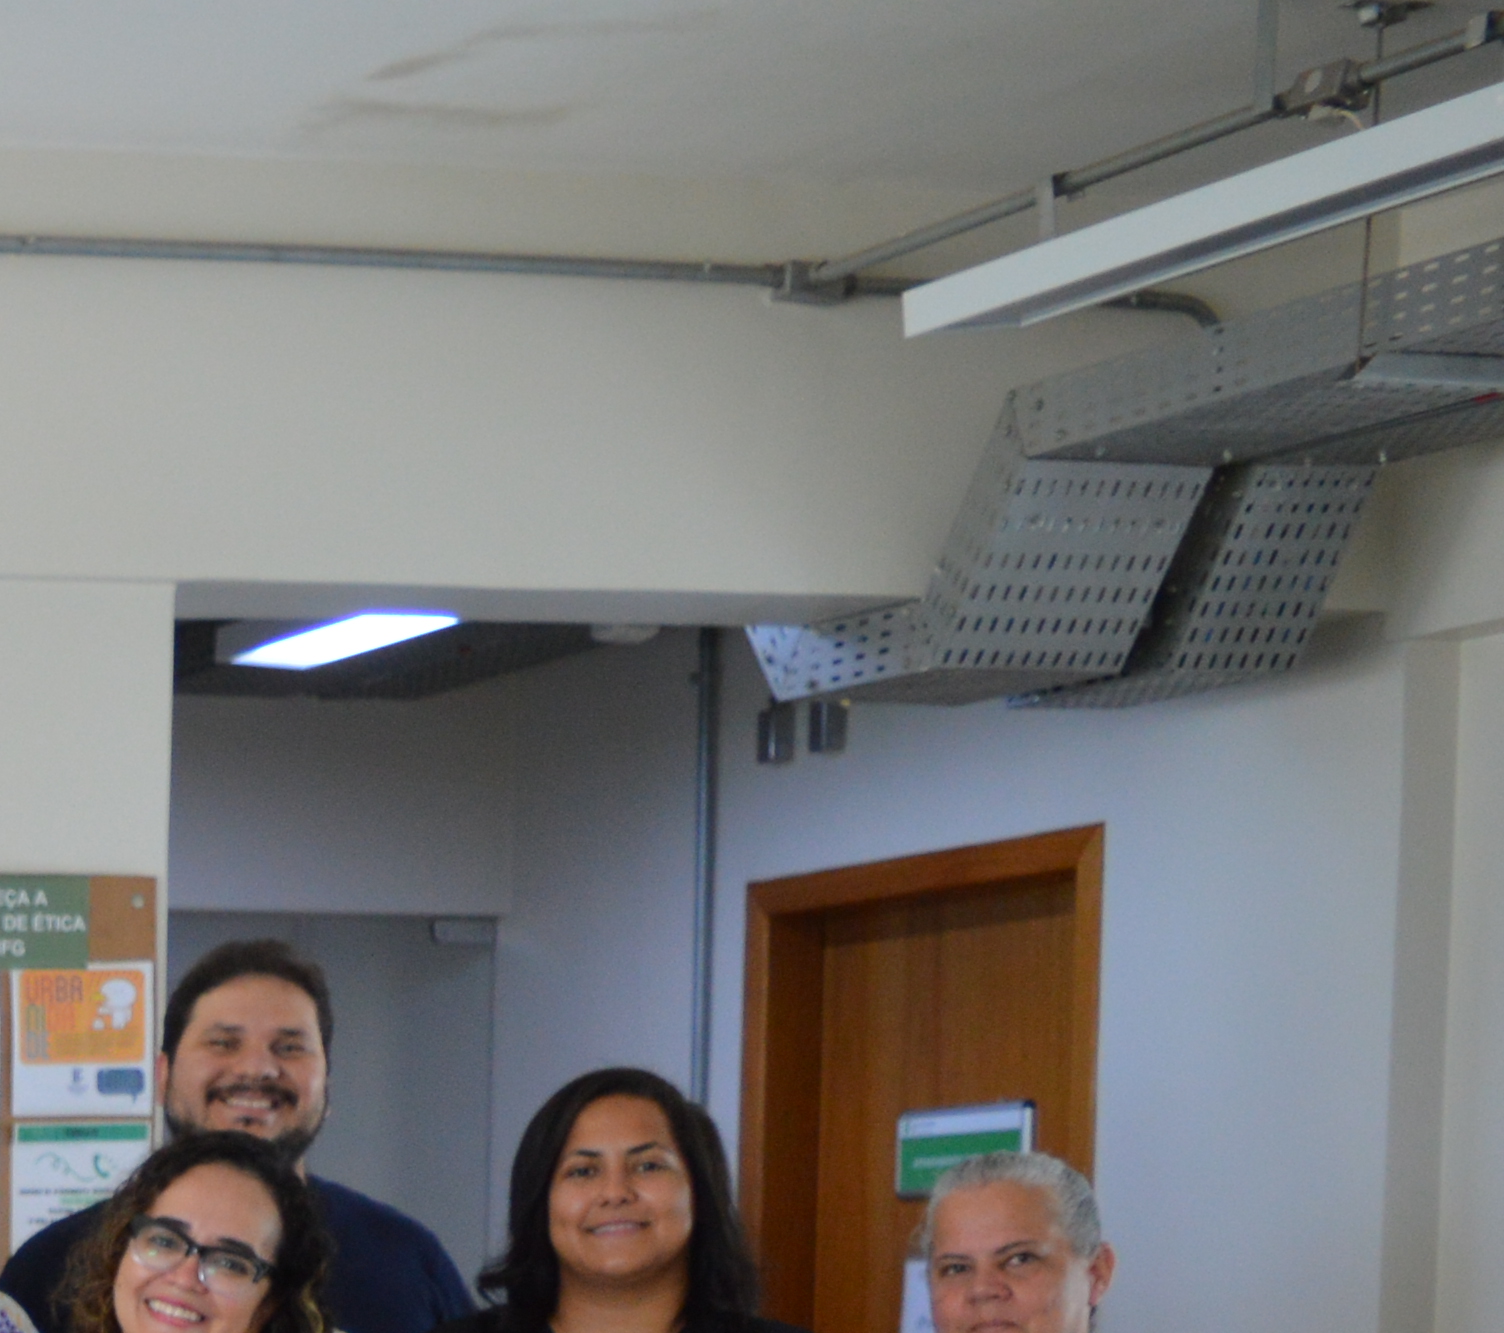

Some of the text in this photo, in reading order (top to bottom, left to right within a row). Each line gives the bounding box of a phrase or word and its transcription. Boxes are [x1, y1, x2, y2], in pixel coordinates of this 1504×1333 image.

[35, 889, 48, 906] A
[3, 914, 27, 931] DE
[32, 911, 86, 931] ÉTICA
